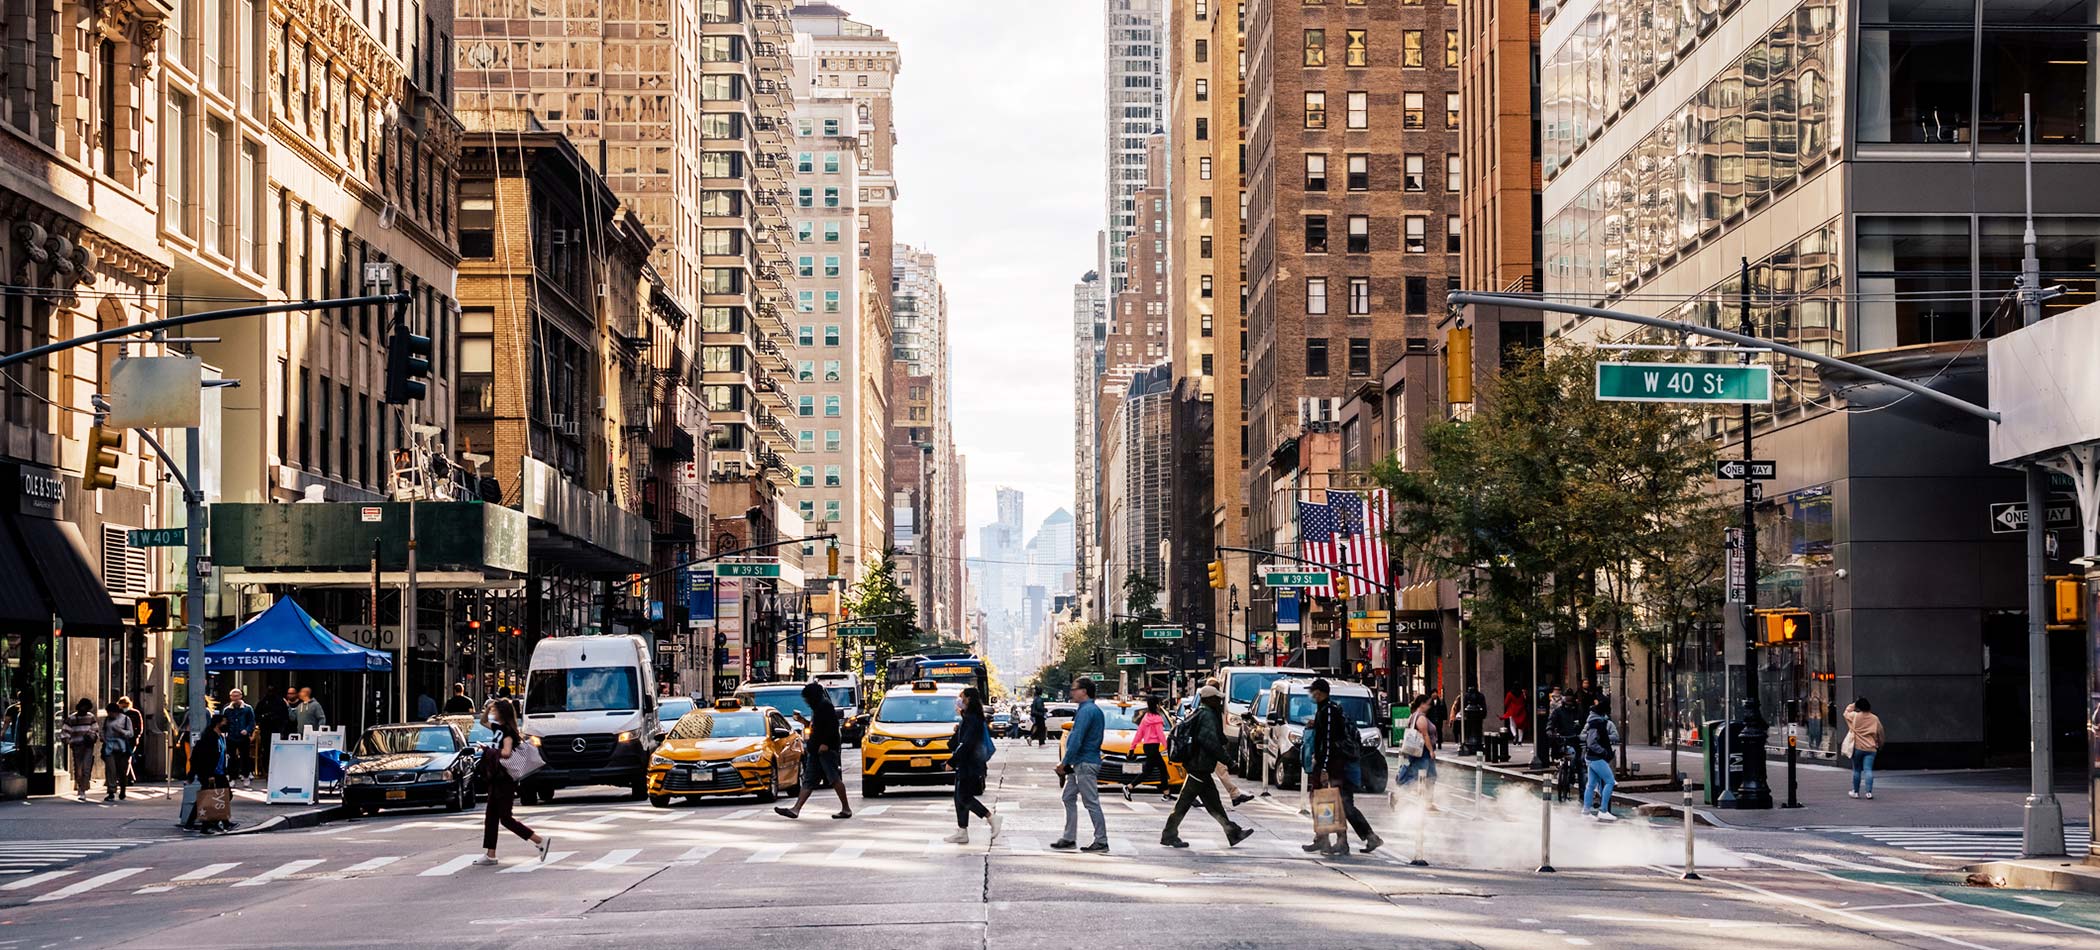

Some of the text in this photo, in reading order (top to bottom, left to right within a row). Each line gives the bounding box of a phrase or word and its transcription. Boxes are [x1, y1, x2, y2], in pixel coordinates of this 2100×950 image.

[1643, 371, 1724, 394] W 40 St
[1725, 466, 1743, 474] ONE
[25, 474, 66, 500] OLE & STEEN
[2005, 508, 2066, 523] ONE AY
[140, 531, 150, 544] W
[154, 531, 170, 544] 40
[732, 566, 763, 575] W 39 St
[1292, 575, 1301, 584] 39
[1304, 575, 1312, 584] St
[222, 656, 234, 665] 19
[238, 656, 286, 664] TESTING
